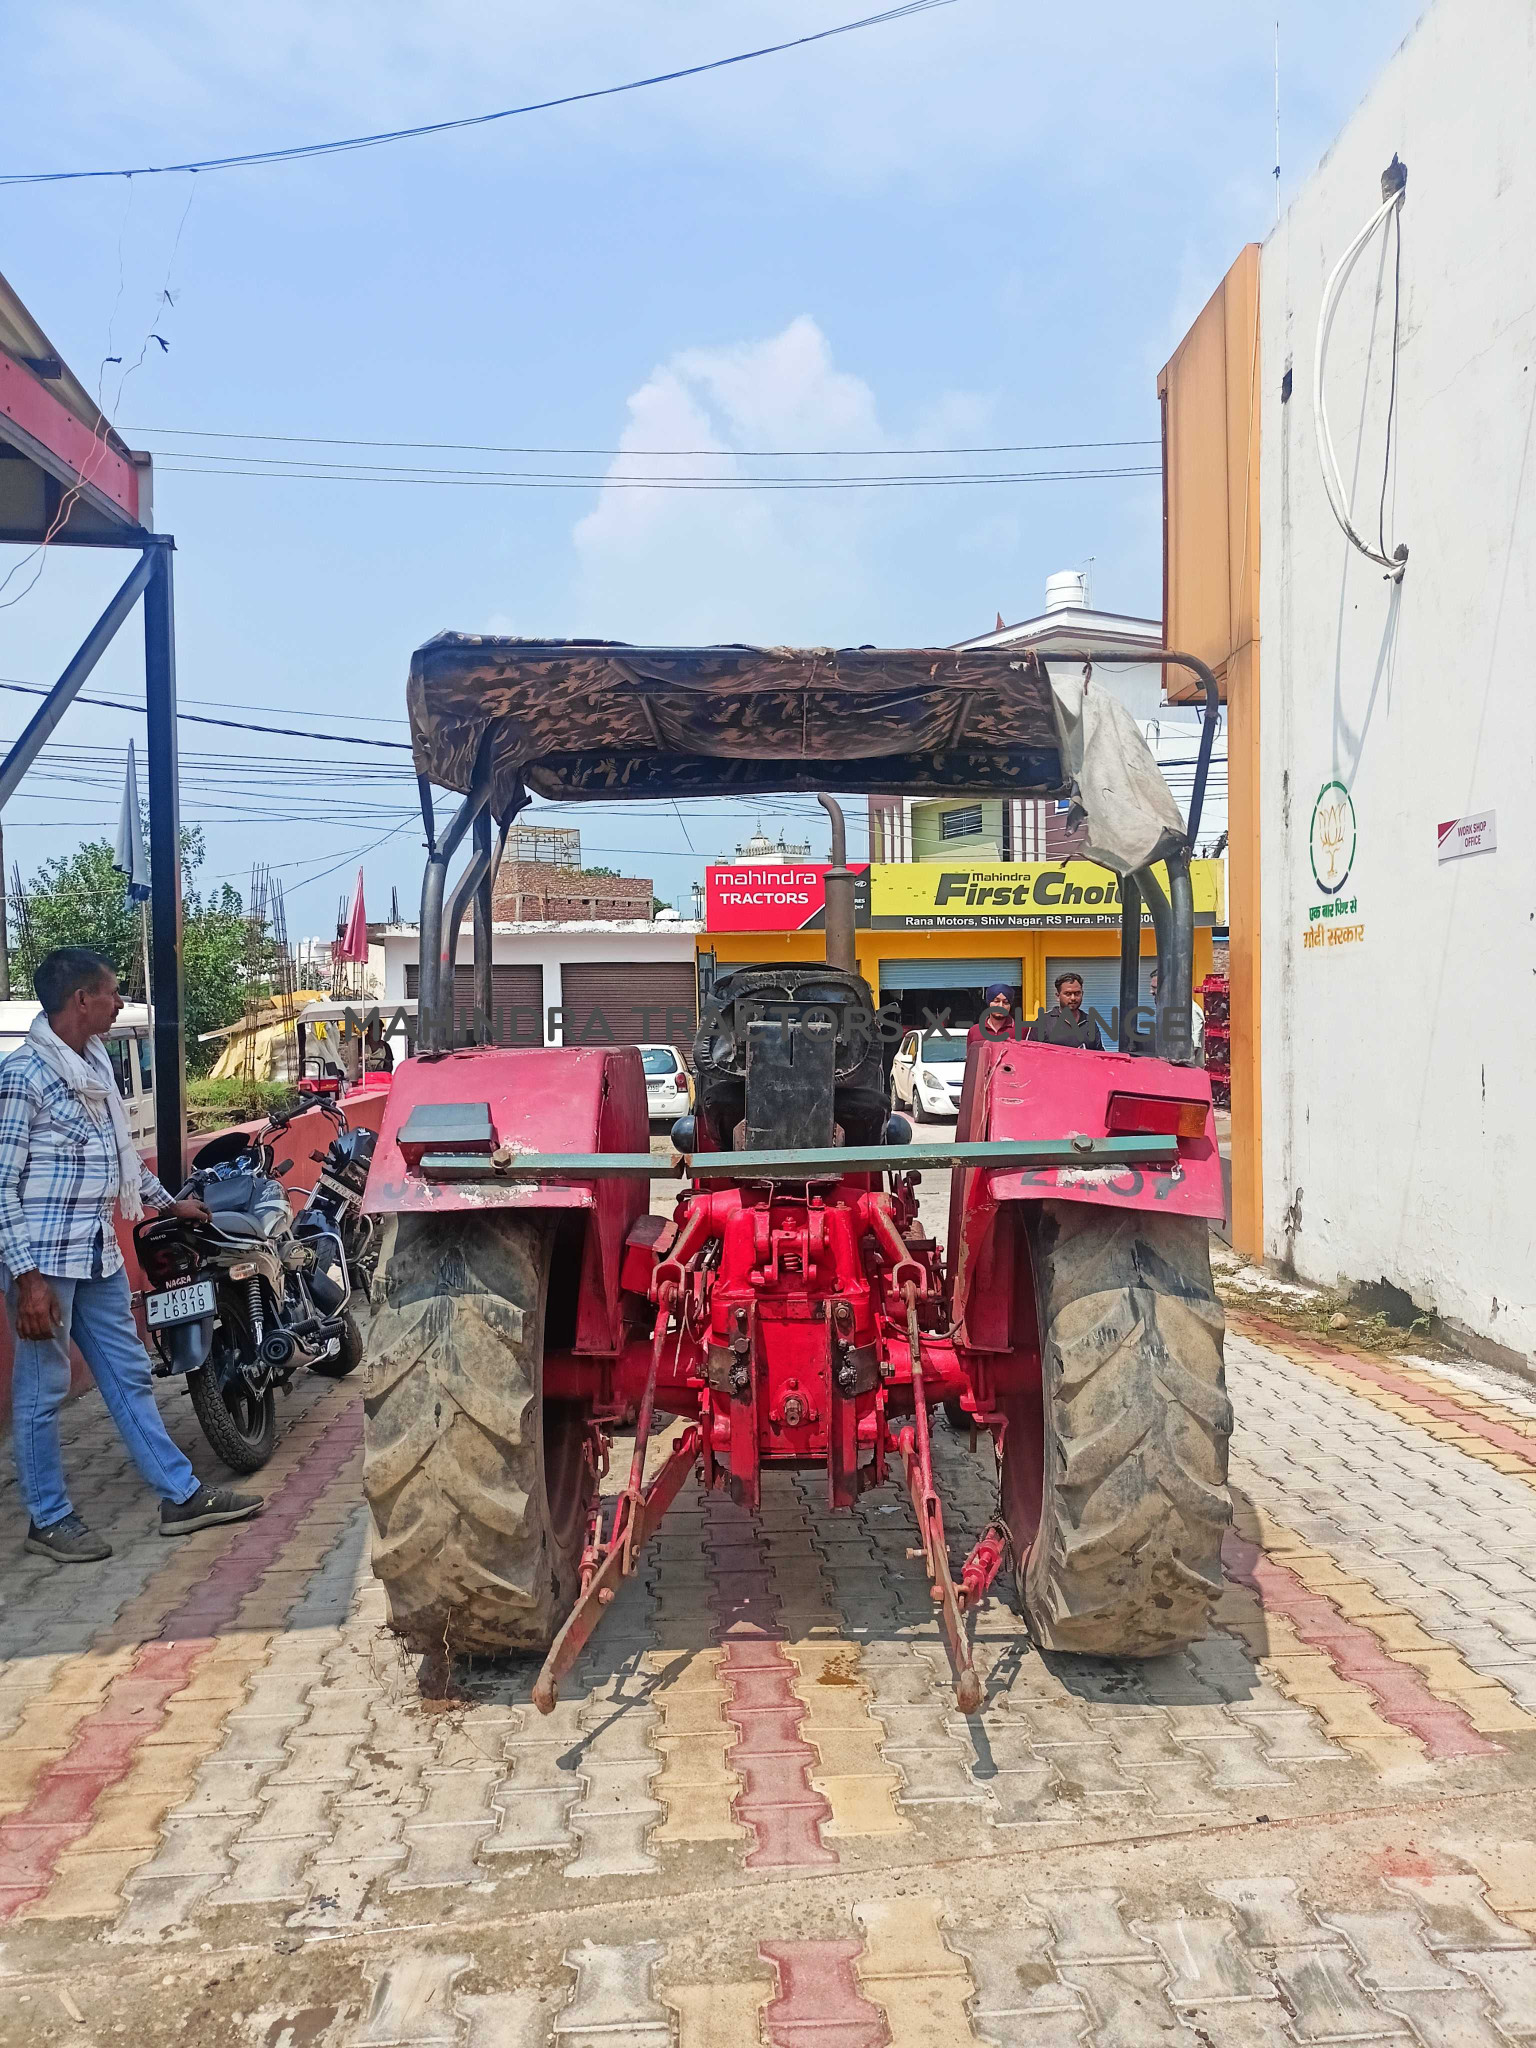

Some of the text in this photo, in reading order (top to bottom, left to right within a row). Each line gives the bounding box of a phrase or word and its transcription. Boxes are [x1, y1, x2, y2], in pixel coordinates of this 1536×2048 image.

[1457, 820, 1487, 837] WORK SHOP
[1464, 835, 1481, 848] OFFICE
[715, 870, 817, 885] mahindra
[972, 873, 1031, 882] Mahindra
[934, 872, 1146, 906] First Choi
[719, 893, 809, 905] TRACTORS
[1309, 906, 1321, 921] एक
[1322, 904, 1334, 918] बार
[1350, 896, 1357, 914] से
[905, 916, 934, 926] Rana
[937, 916, 978, 927] Motors,
[981, 916, 1005, 926] Shiv
[1008, 915, 1043, 927] Nagar,
[1046, 915, 1062, 925] RS
[1065, 915, 1094, 925] Pura.
[1097, 915, 1115, 925] Ph:
[1328, 924, 1365, 946] सरकार
[165, 1274, 192, 1290] NAGRA
[163, 1284, 204, 1306] JK02C
[163, 1298, 205, 1319] L6319
